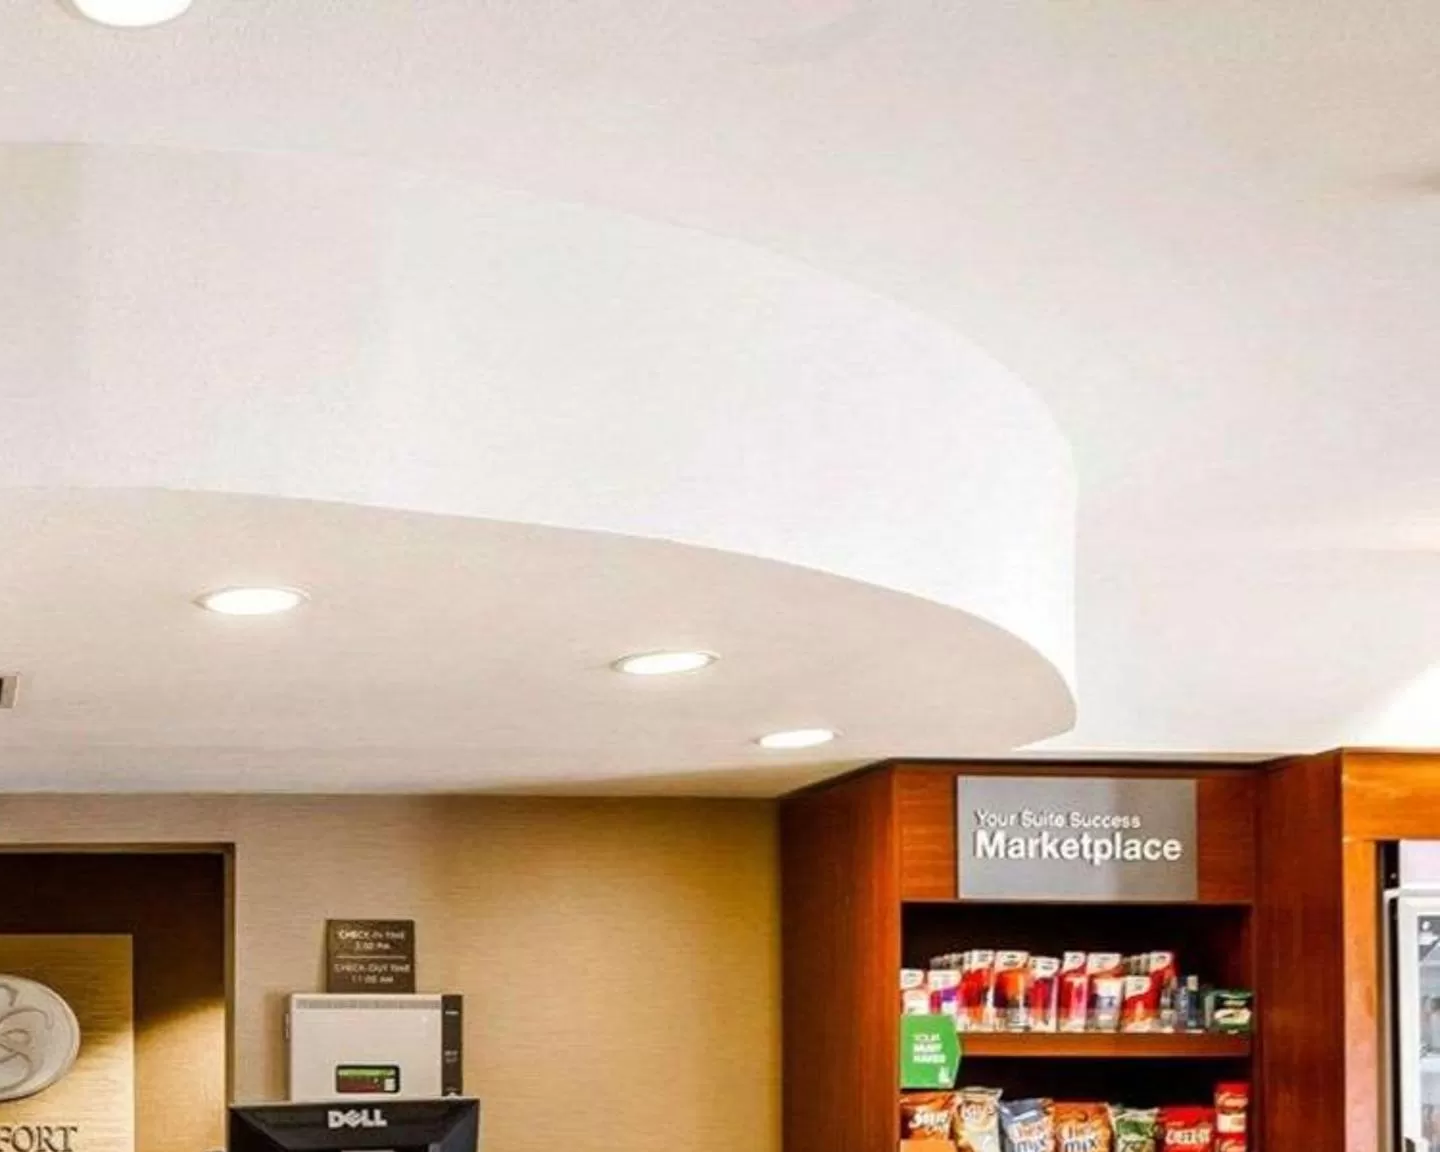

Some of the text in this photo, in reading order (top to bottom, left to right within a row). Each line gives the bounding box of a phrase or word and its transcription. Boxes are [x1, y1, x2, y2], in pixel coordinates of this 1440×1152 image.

[974, 810, 1142, 829] Your Suite Success
[973, 830, 1183, 866] Marketplace
[327, 1108, 388, 1129] DELL
